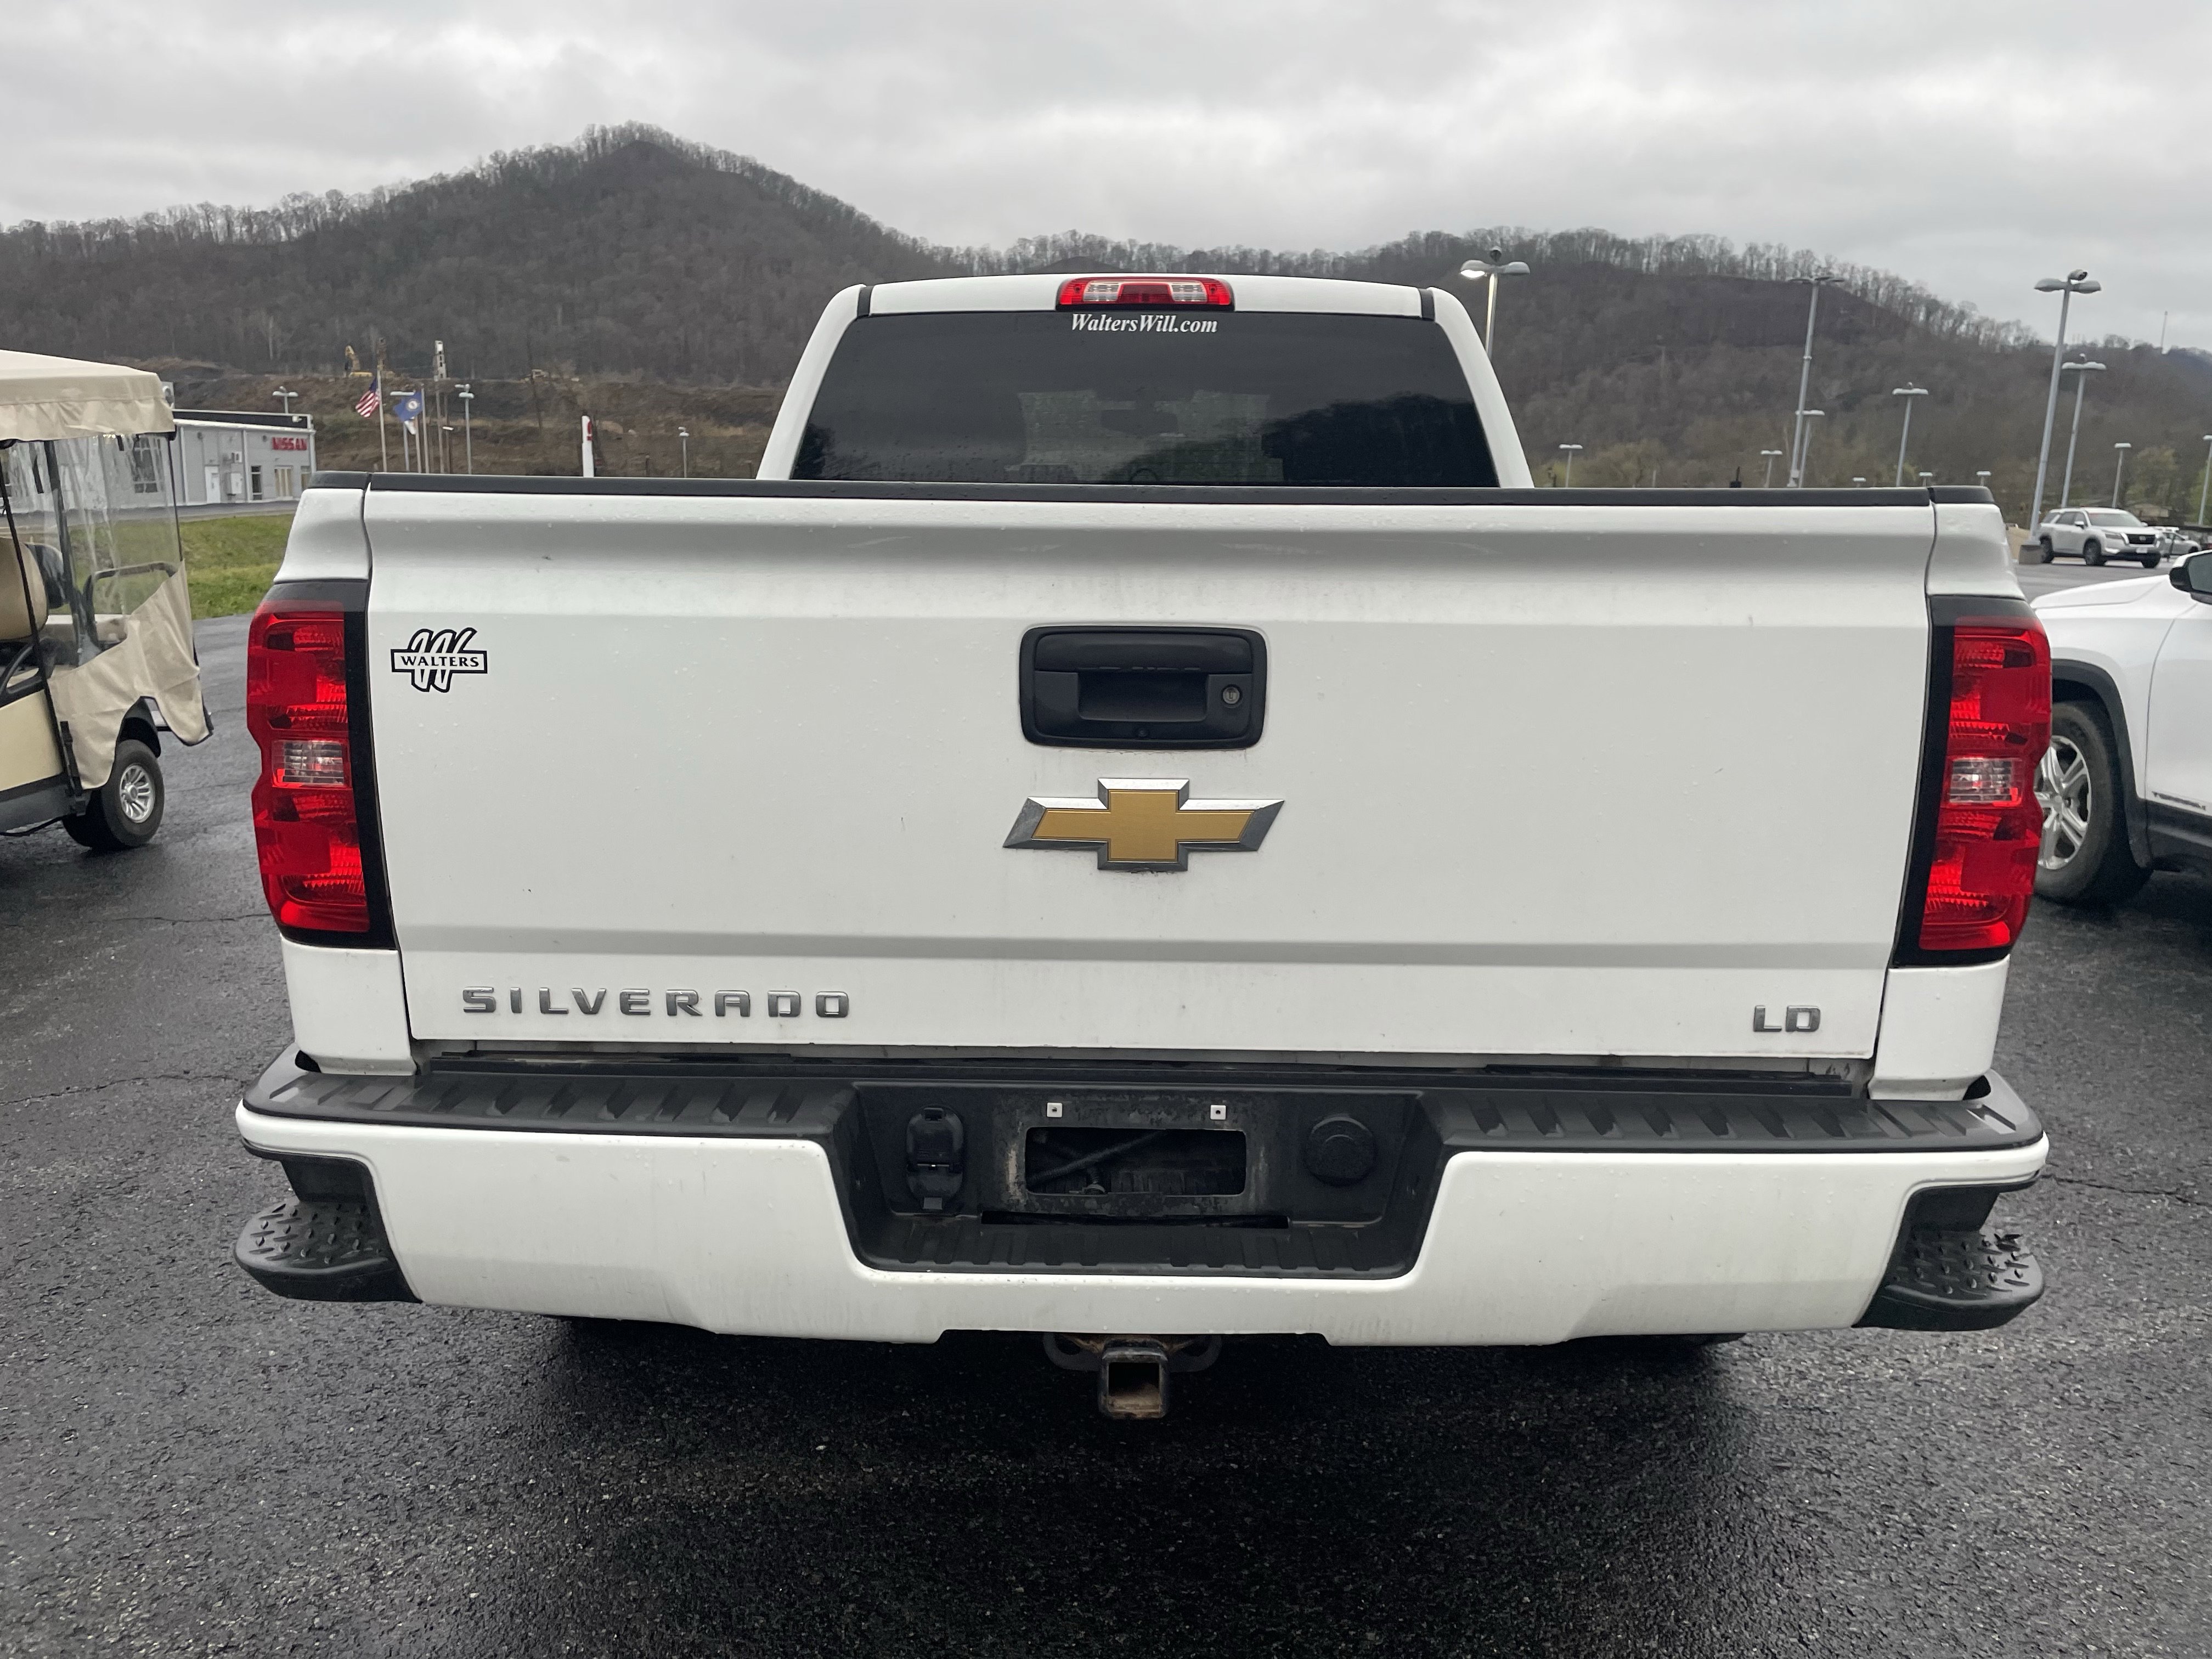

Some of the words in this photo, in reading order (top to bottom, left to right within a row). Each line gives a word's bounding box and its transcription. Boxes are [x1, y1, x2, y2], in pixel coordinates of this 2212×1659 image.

[1071, 313, 1218, 333] WaltersWill.com
[272, 437, 307, 450] NISSAN
[400, 655, 479, 667] WALTERS
[462, 986, 849, 1018] SILVERADO
[1753, 1005, 1821, 1032] LD
